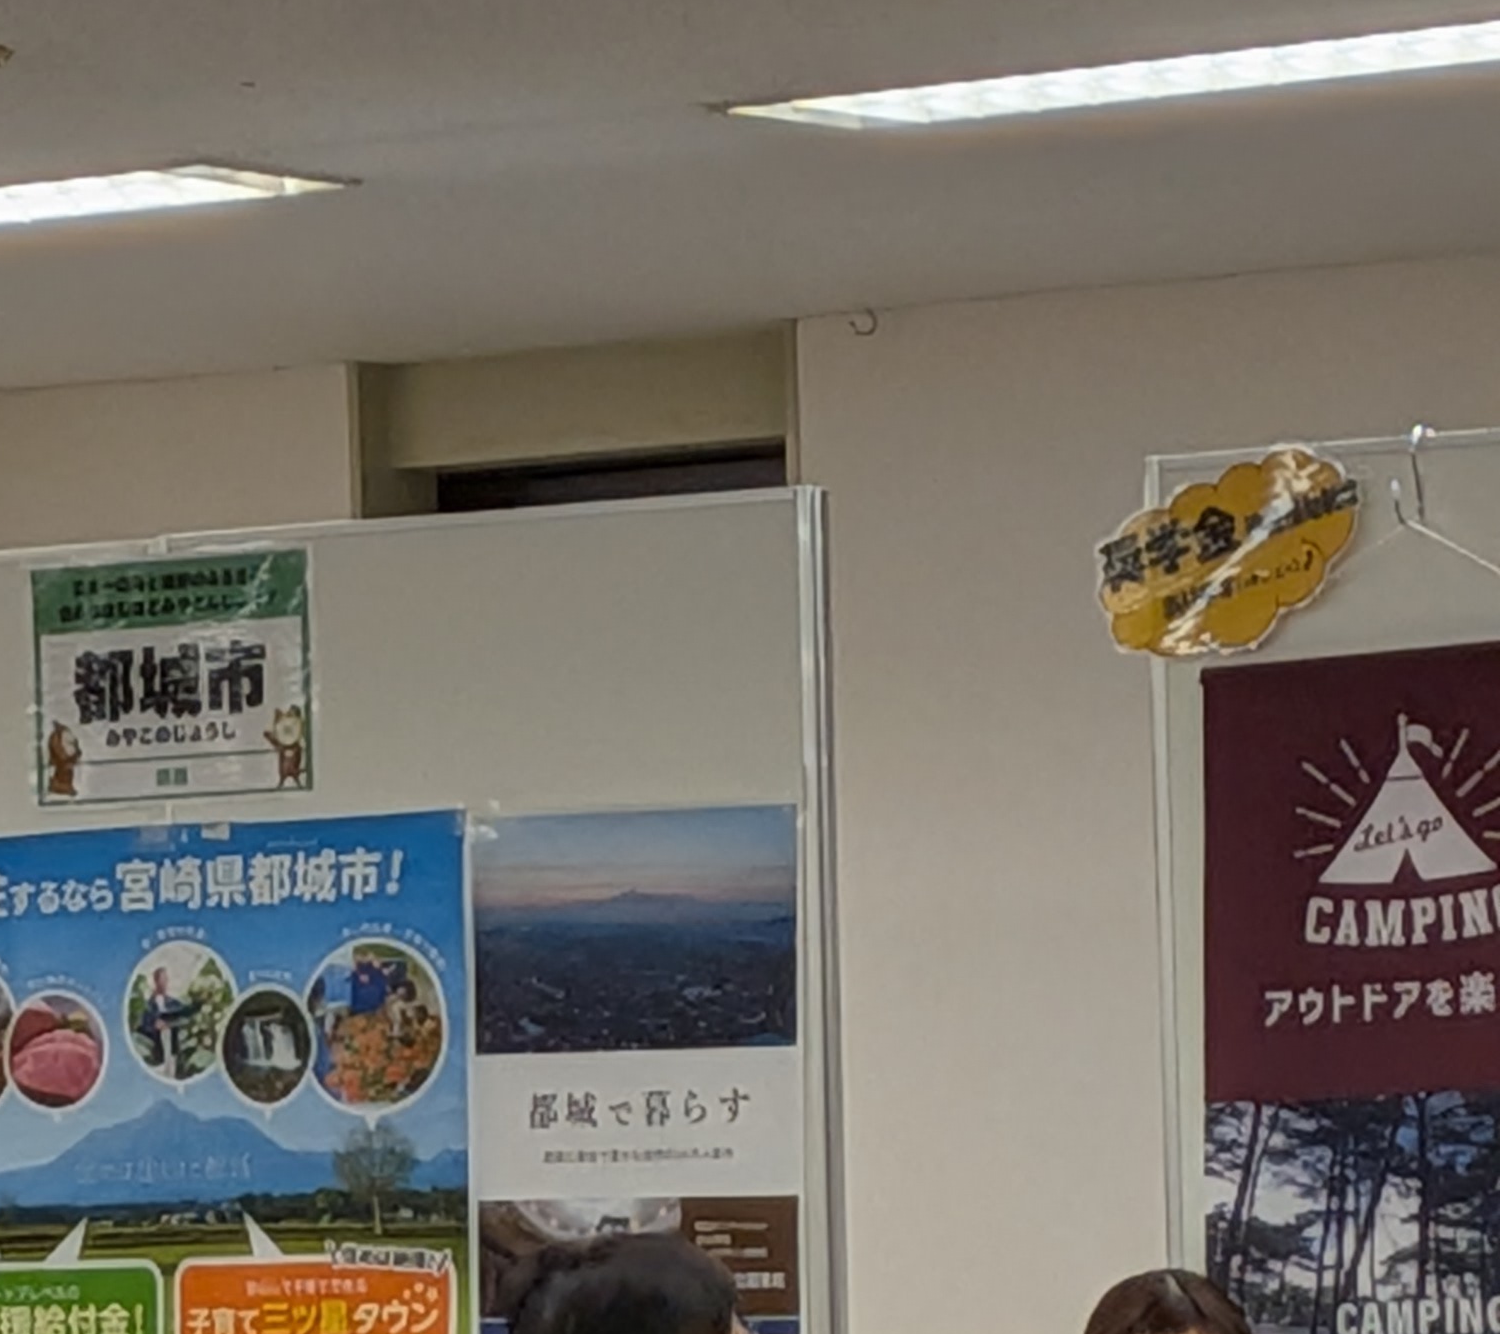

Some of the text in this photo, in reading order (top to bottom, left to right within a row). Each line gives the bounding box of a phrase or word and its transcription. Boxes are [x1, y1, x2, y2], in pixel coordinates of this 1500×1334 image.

[73, 640, 267, 724] 都城市
[1304, 885, 1500, 947] CAMPIN
[1264, 971, 1497, 1027] アウトドアを楽
[529, 1087, 750, 1129] 都城で暮らす
